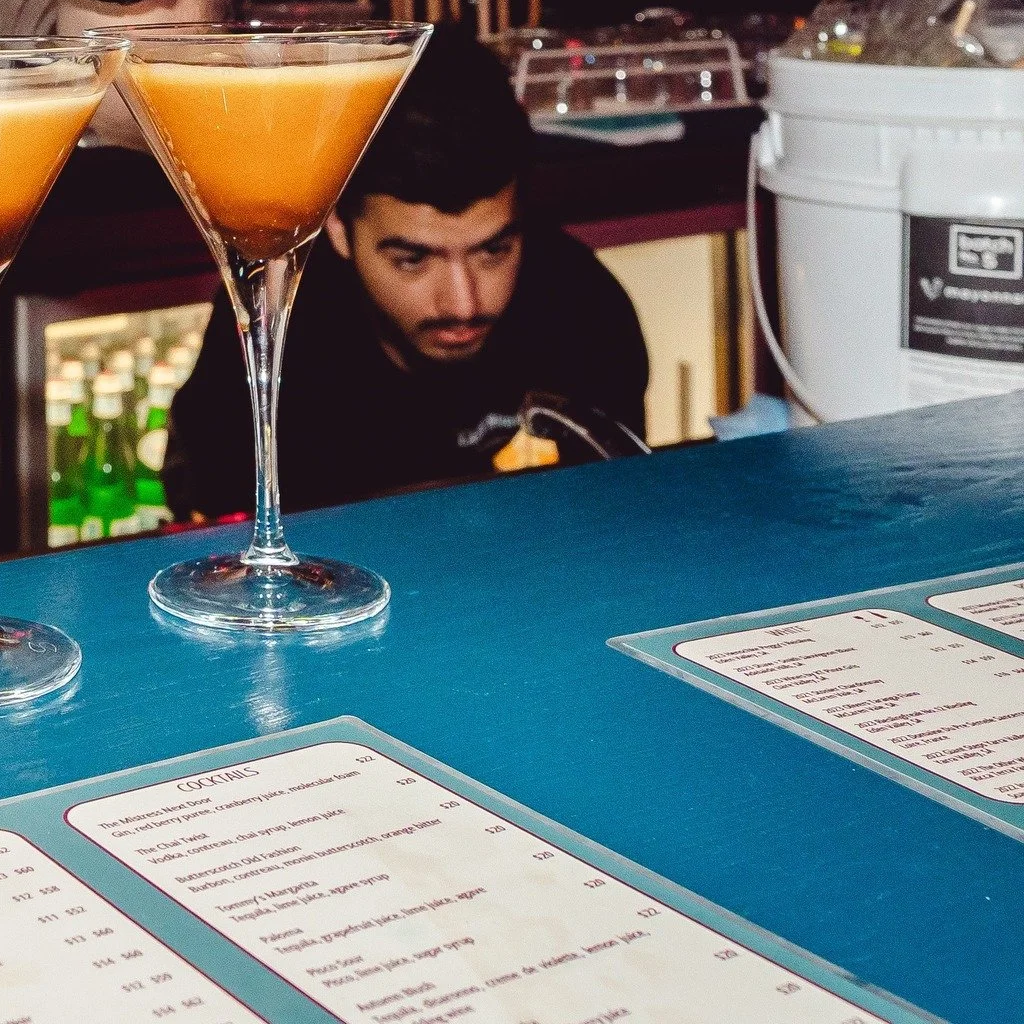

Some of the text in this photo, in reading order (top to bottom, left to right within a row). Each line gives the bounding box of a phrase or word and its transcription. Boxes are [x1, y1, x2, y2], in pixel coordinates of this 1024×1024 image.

[765, 626, 810, 637] WHITE
[355, 755, 376, 763] $22
[177, 767, 259, 792] COCKTAILS
[396, 777, 417, 786] $20
[111, 771, 361, 838] Gin, red berry puree, cranberry juice, molecular foam
[439, 801, 460, 809] $20
[97, 797, 212, 830] The Mistress Next Door
[147, 852, 188, 864] Vodka,
[236, 831, 259, 842] chai
[257, 825, 291, 836] syrup,
[286, 816, 322, 827] lemon
[318, 809, 346, 820] juice
[484, 825, 506, 834] $20
[134, 833, 210, 856] The Chai Twist
[188, 878, 235, 893] Burbon,
[282, 854, 318, 867] monin
[381, 826, 416, 839] orange
[412, 819, 442, 830] bitter
[532, 851, 555, 861] $20
[14, 866, 35, 875] $60
[175, 846, 302, 883] Butterscotch Old Fashion
[264, 881, 319, 898] Margarita
[583, 879, 606, 889] $20
